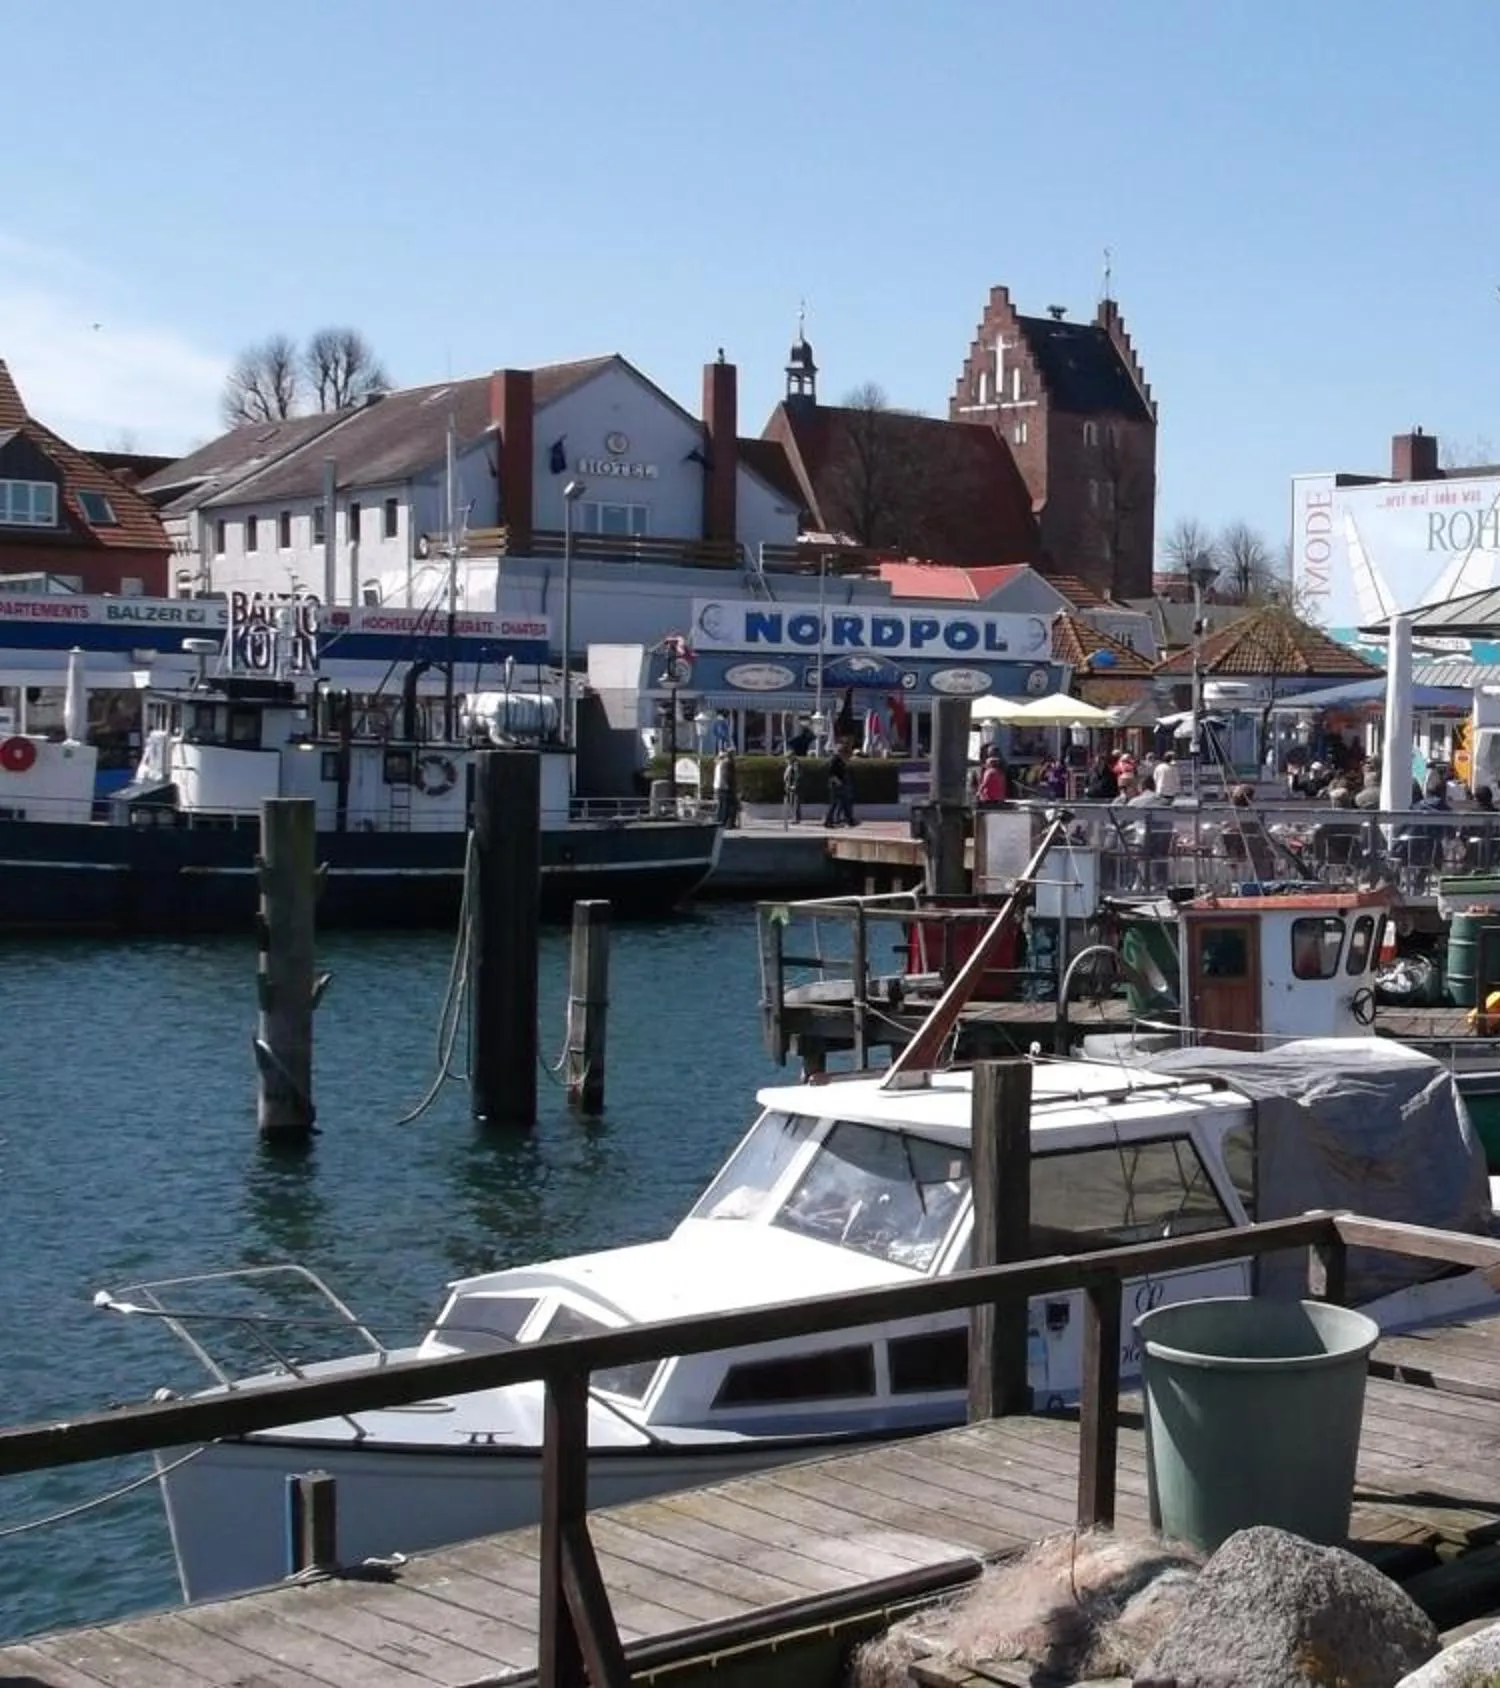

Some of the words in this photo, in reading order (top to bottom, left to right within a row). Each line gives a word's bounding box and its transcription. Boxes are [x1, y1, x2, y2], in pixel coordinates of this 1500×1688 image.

[577, 459, 658, 478] HOTEL
[1304, 487, 1334, 600] MODE
[106, 604, 182, 622] BALZER
[745, 611, 1008, 652] NORDPOL
